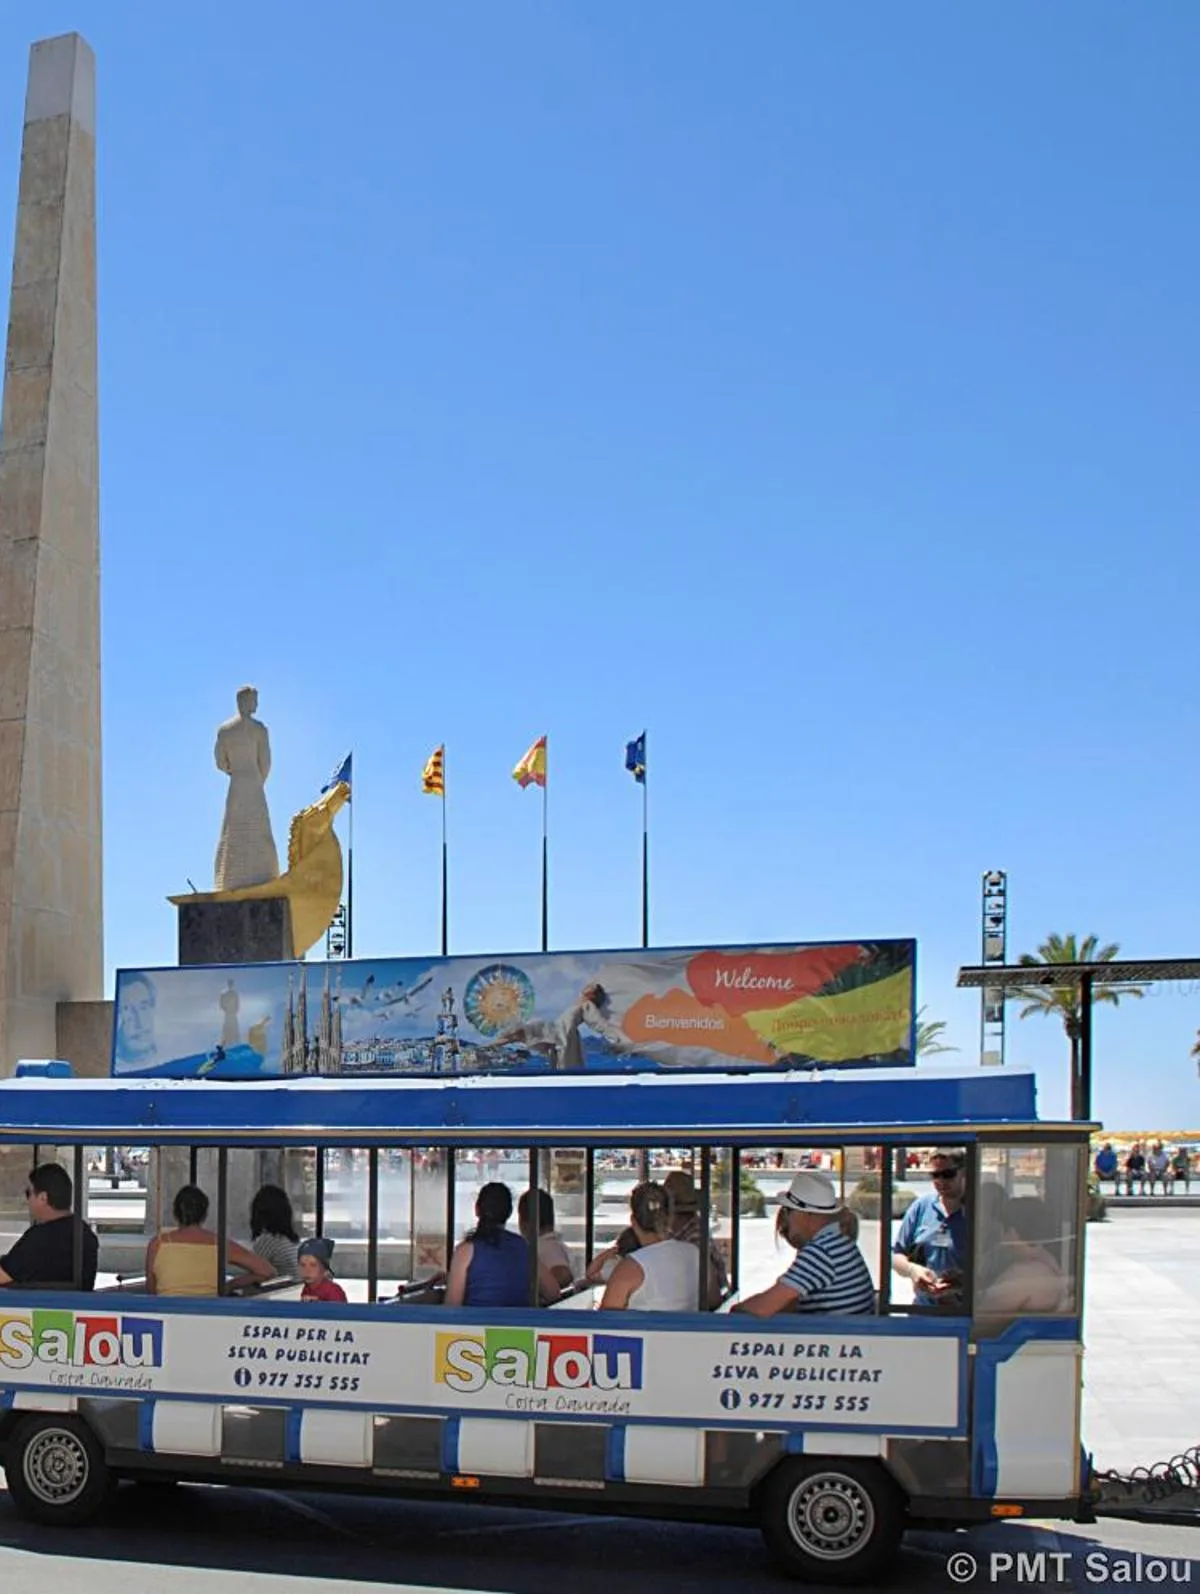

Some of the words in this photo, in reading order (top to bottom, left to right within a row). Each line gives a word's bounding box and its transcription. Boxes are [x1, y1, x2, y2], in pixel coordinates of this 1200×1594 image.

[714, 968, 795, 990] Welcome
[644, 1014, 725, 1031] Bienvenidos
[242, 1325, 289, 1339] ESPAI
[296, 1328, 328, 1341] PER
[334, 1329, 354, 1343] LA
[228, 1346, 268, 1359] SEVA
[275, 1349, 371, 1365] PUBLICITAT
[729, 1342, 785, 1356] ESPAI
[793, 1343, 831, 1358] PER
[839, 1344, 864, 1359] LA
[443, 1338, 633, 1393] Salou
[712, 1365, 760, 1379] SEVA
[768, 1367, 883, 1383] PUBLICITAT
[49, 1370, 85, 1386] Costa
[90, 1371, 153, 1389] Daurada
[258, 1372, 288, 1387] 977
[294, 1374, 324, 1388] 353
[329, 1376, 360, 1391] 555
[505, 1393, 550, 1410] Costa
[555, 1395, 632, 1413] Daurada
[748, 1392, 785, 1408] 977
[792, 1394, 827, 1410] 353
[834, 1395, 871, 1411] 555
